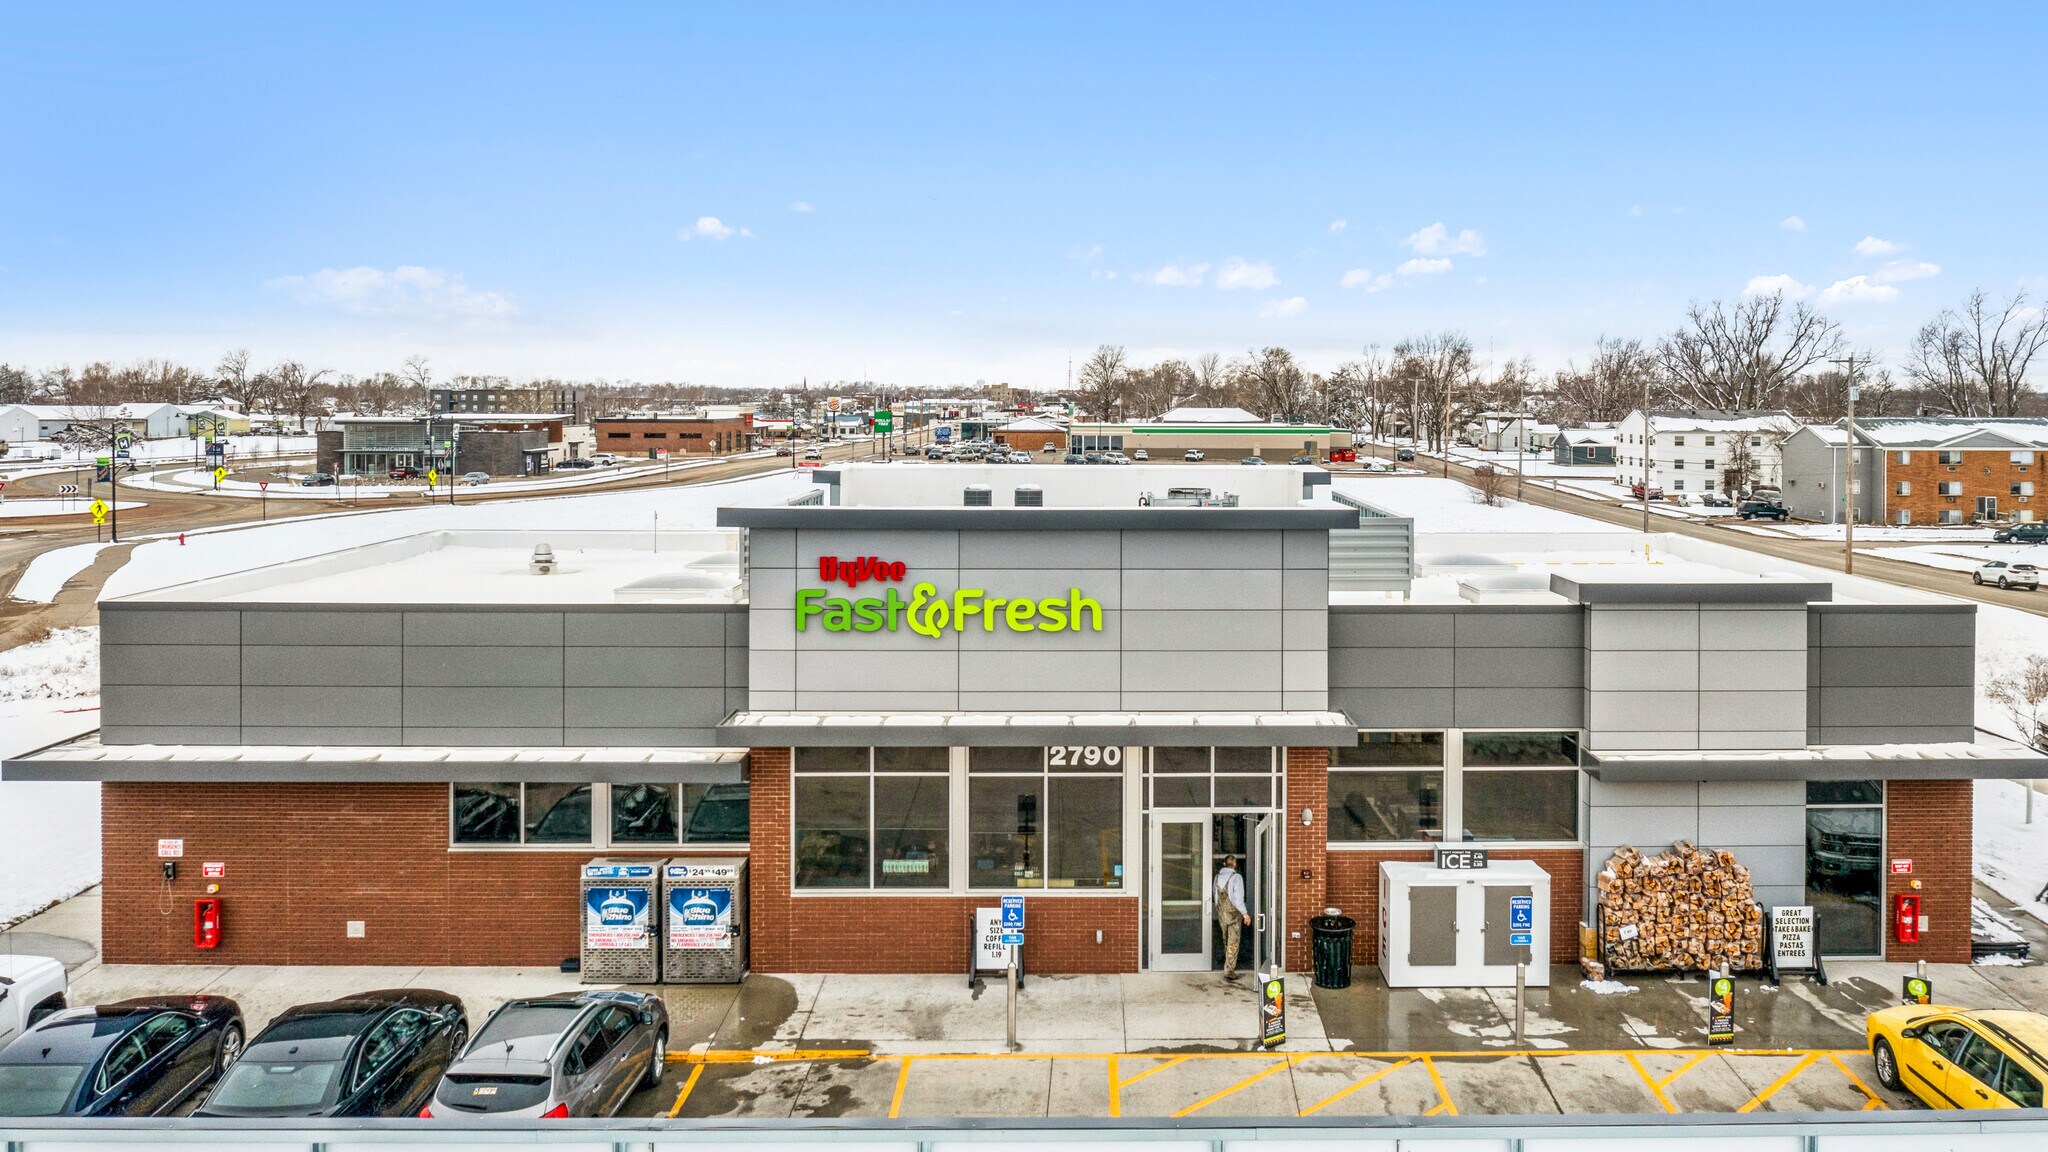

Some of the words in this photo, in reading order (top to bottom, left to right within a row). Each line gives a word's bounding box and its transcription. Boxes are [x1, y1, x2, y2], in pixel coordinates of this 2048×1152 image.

[120, 440, 128, 449] M
[819, 556, 906, 588] HyVee
[1050, 746, 1121, 766] 2790
[1441, 854, 1471, 869] ICE
